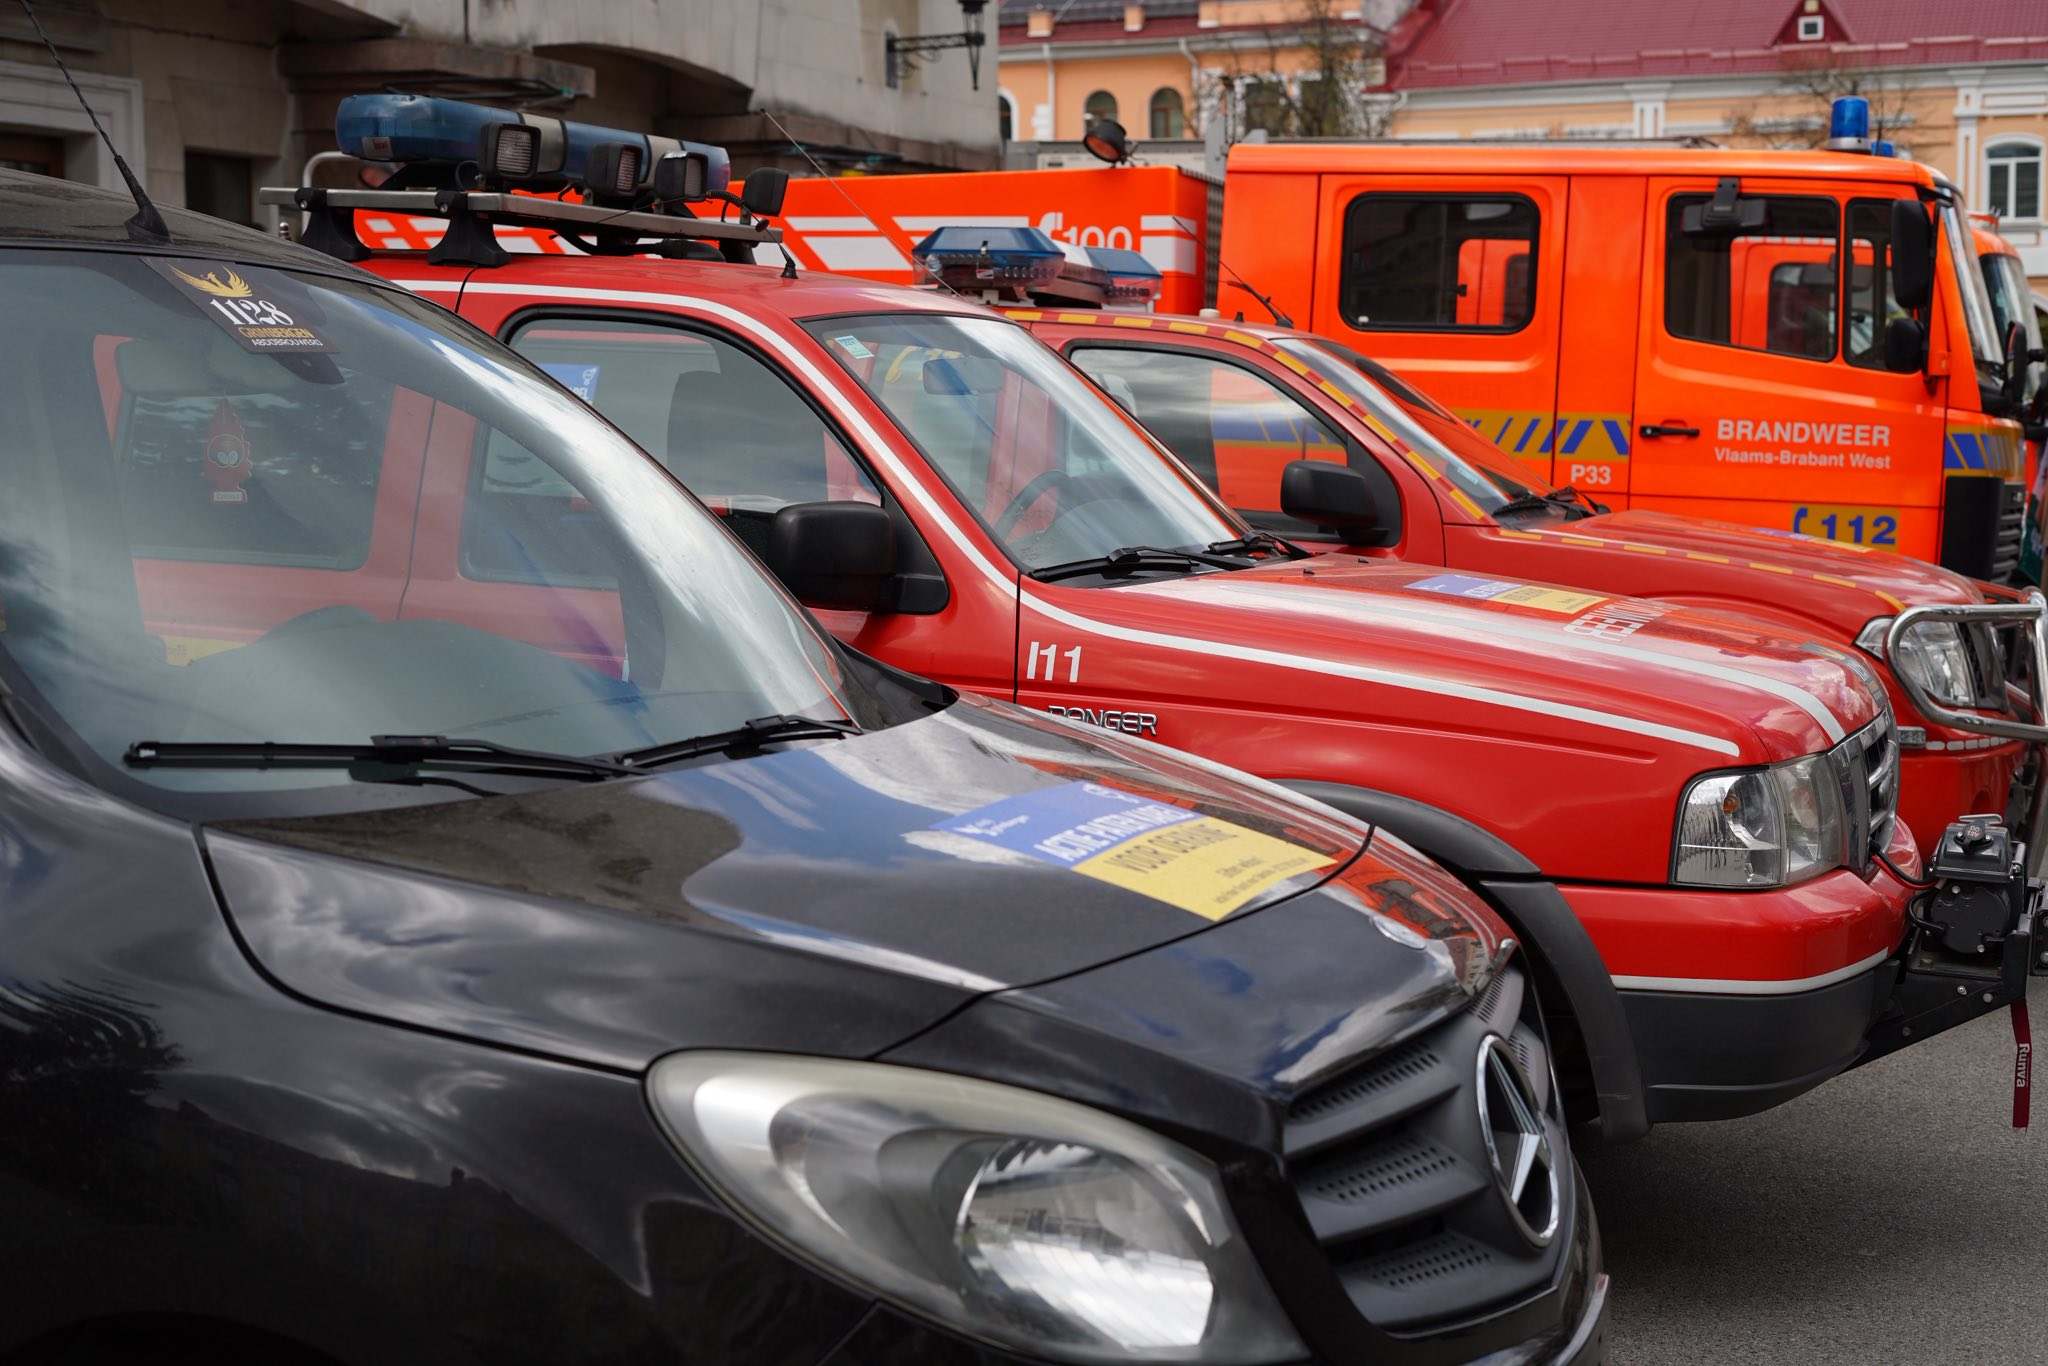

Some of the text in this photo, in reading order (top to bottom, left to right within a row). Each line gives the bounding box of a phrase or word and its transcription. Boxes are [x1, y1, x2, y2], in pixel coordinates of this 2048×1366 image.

[210, 299, 294, 326] 1128
[238, 327, 315, 338] GRIMBERGEN
[1717, 419, 1891, 447] BRANDWEER
[1714, 447, 1891, 470] Vlaams-Brabant West
[1570, 464, 1612, 485] P33
[1820, 514, 1898, 545] 112
[1034, 829, 1111, 862] ACTIE
[2016, 1043, 2030, 1088] Runva
